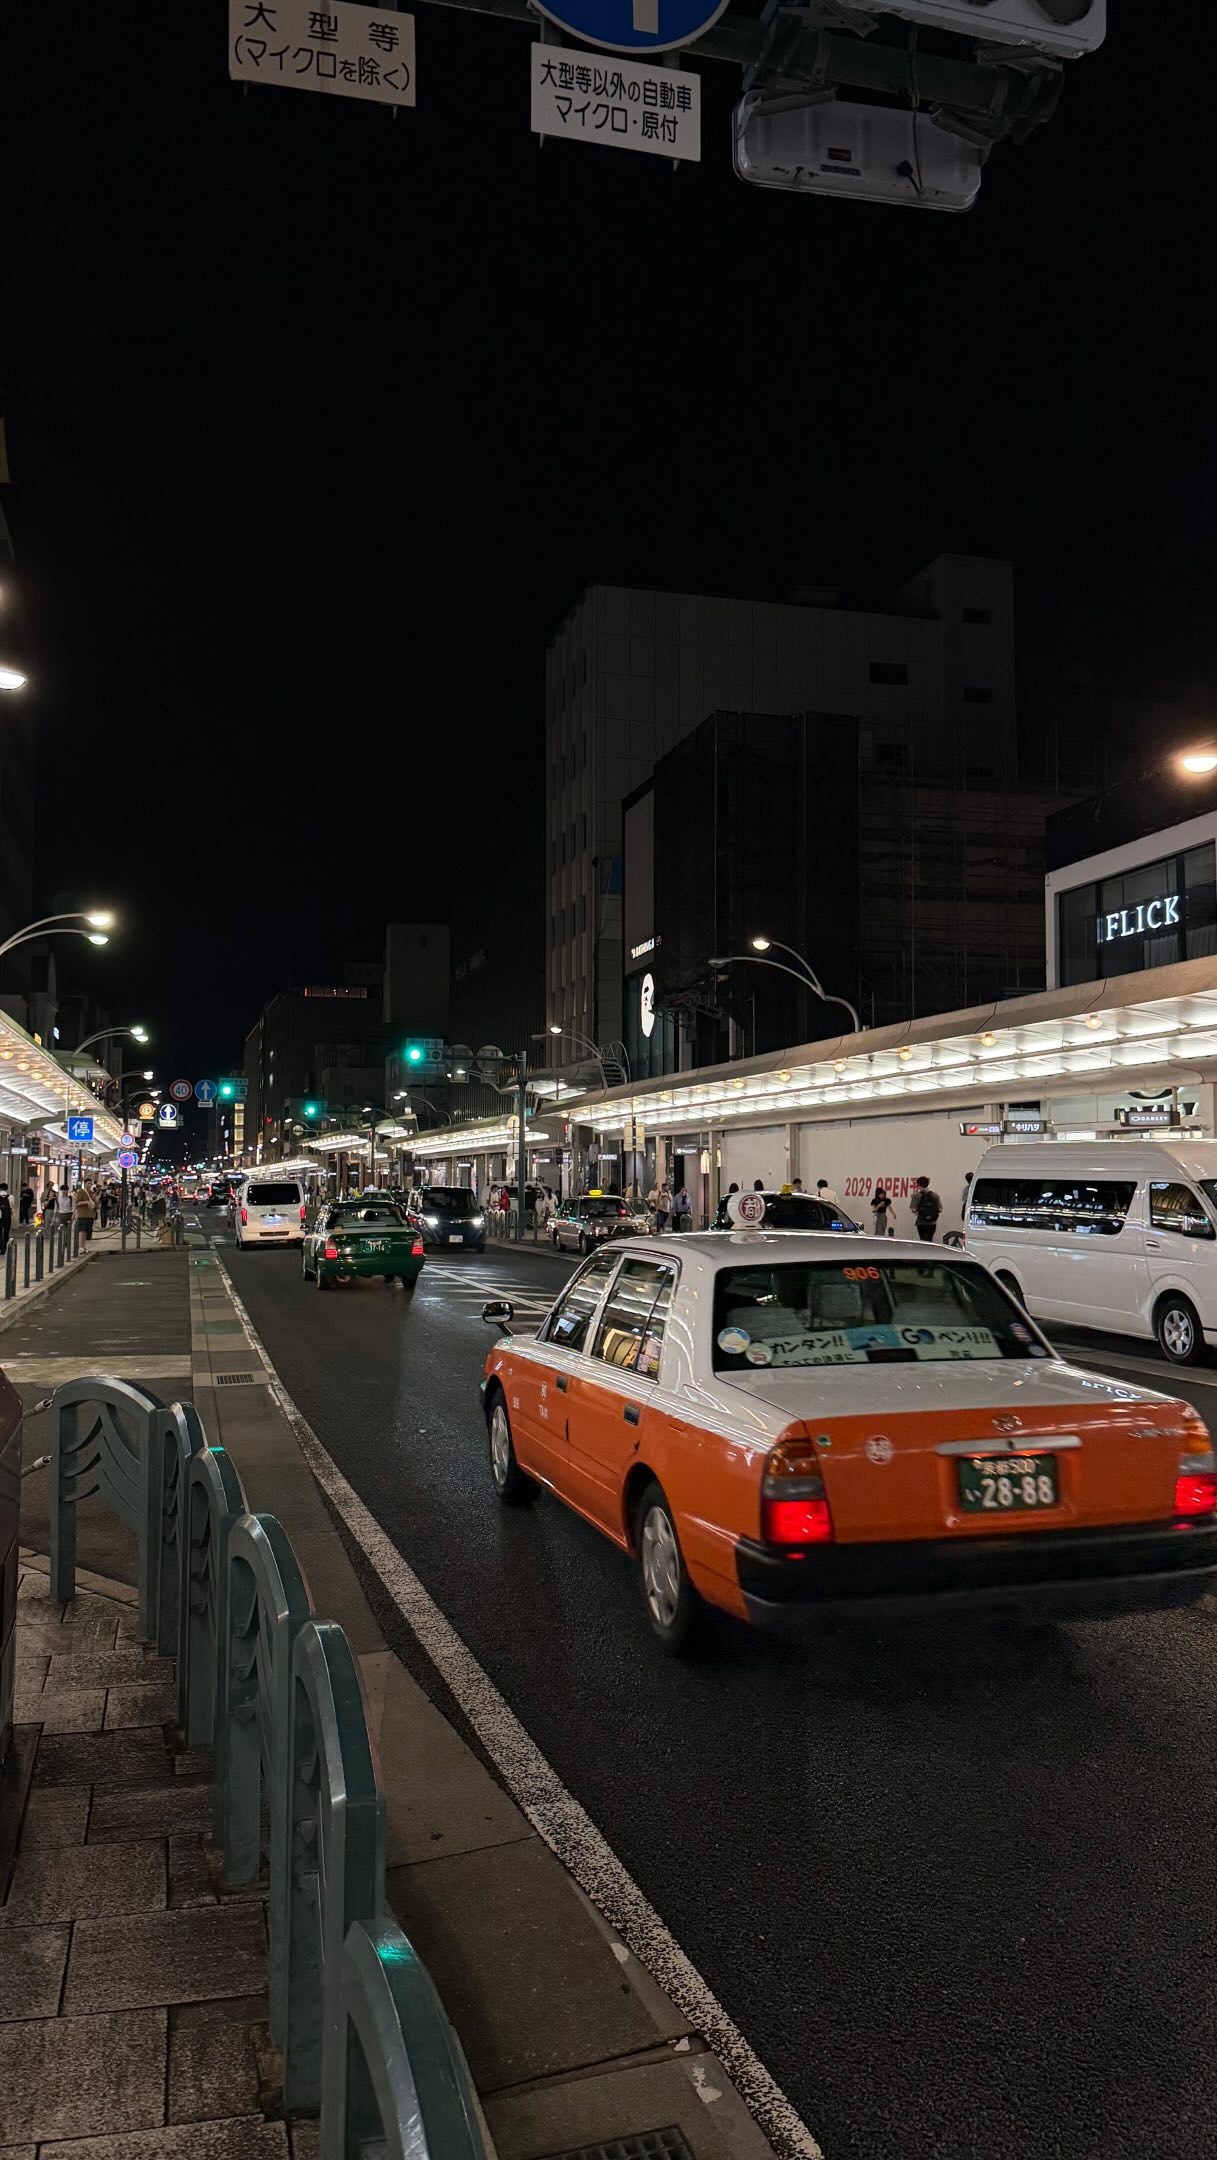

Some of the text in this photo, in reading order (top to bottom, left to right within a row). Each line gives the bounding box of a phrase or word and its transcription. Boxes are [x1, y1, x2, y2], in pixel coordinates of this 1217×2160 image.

[234, 35, 410, 91] (マイクロを除く)
[540, 59, 693, 112] 大型等以外の自動車
[554, 95, 679, 143] マイクロ・原付
[1105, 895, 1180, 942] FLICK
[176, 1085, 188, 1095] 40
[72, 1120, 90, 1137] 停
[844, 1177, 873, 1197] 2029
[843, 1266, 880, 1281] 906
[980, 1475, 1055, 1508] 28-88
